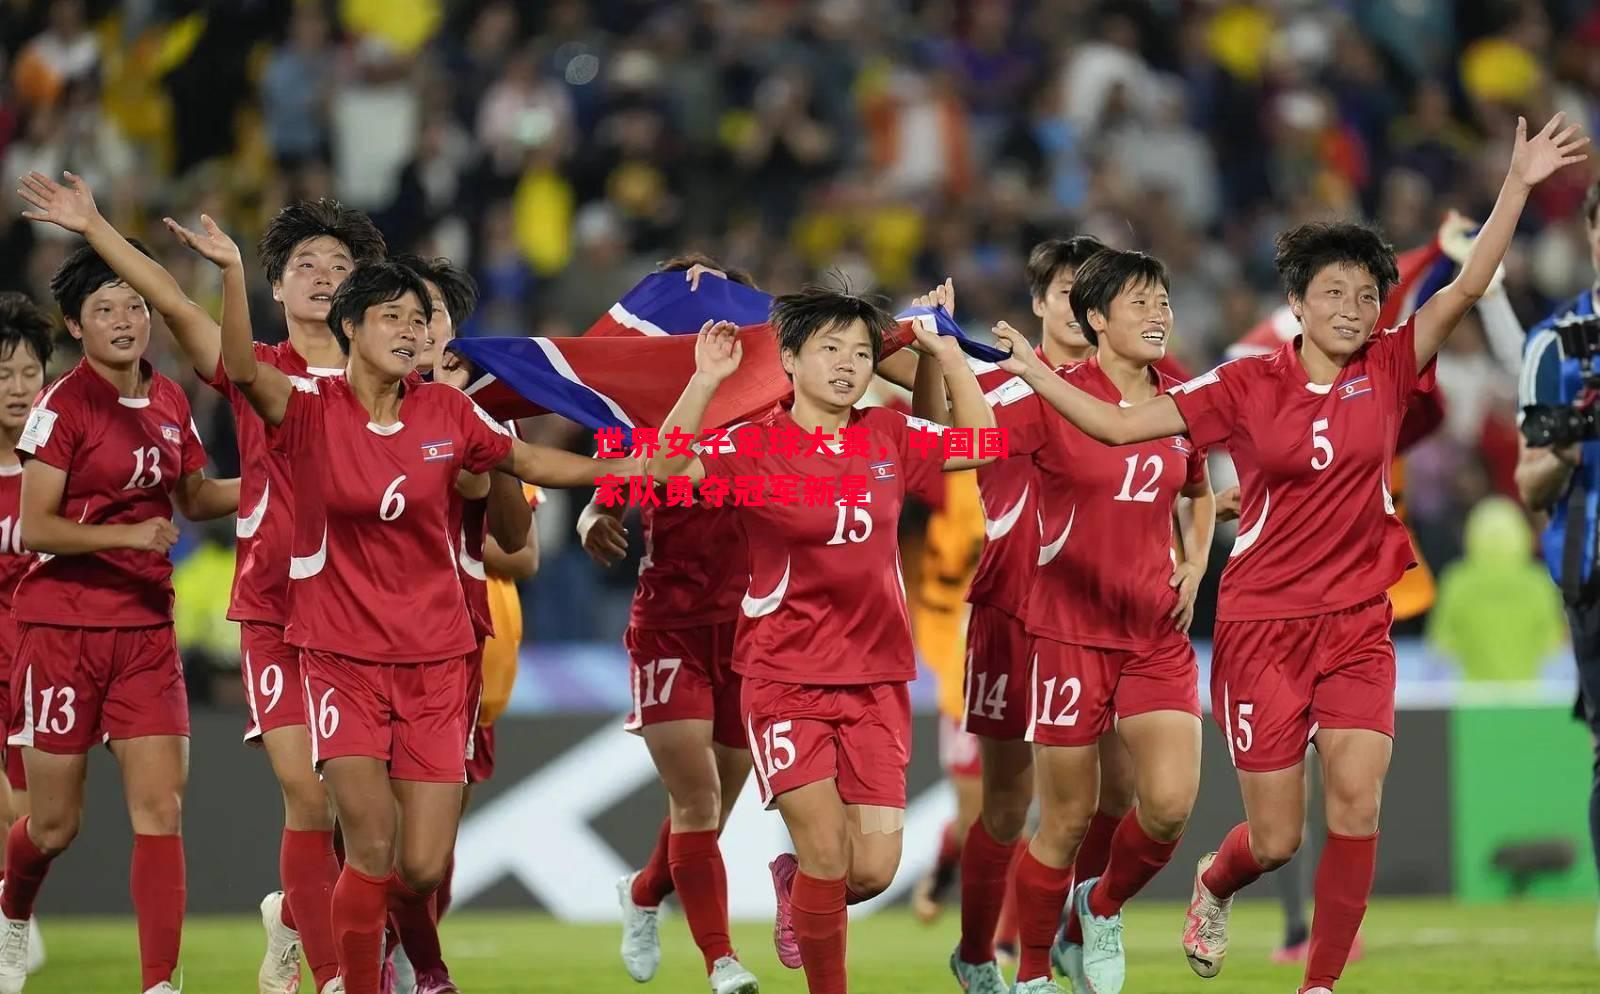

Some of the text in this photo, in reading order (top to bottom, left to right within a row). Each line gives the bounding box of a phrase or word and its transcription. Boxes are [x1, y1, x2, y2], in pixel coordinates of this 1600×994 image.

[123, 446, 162, 489] 13
[1311, 417, 1334, 470] 5
[379, 474, 406, 521] 6
[1113, 453, 1164, 503] 12
[826, 491, 873, 545] 15
[260, 664, 284, 714] 9
[641, 659, 682, 707] 17
[970, 672, 1008, 720] 14
[1036, 676, 1082, 727] 12
[35, 686, 76, 735] 13
[318, 687, 340, 739] 6
[1236, 704, 1254, 752] 5
[762, 720, 797, 778] 15
